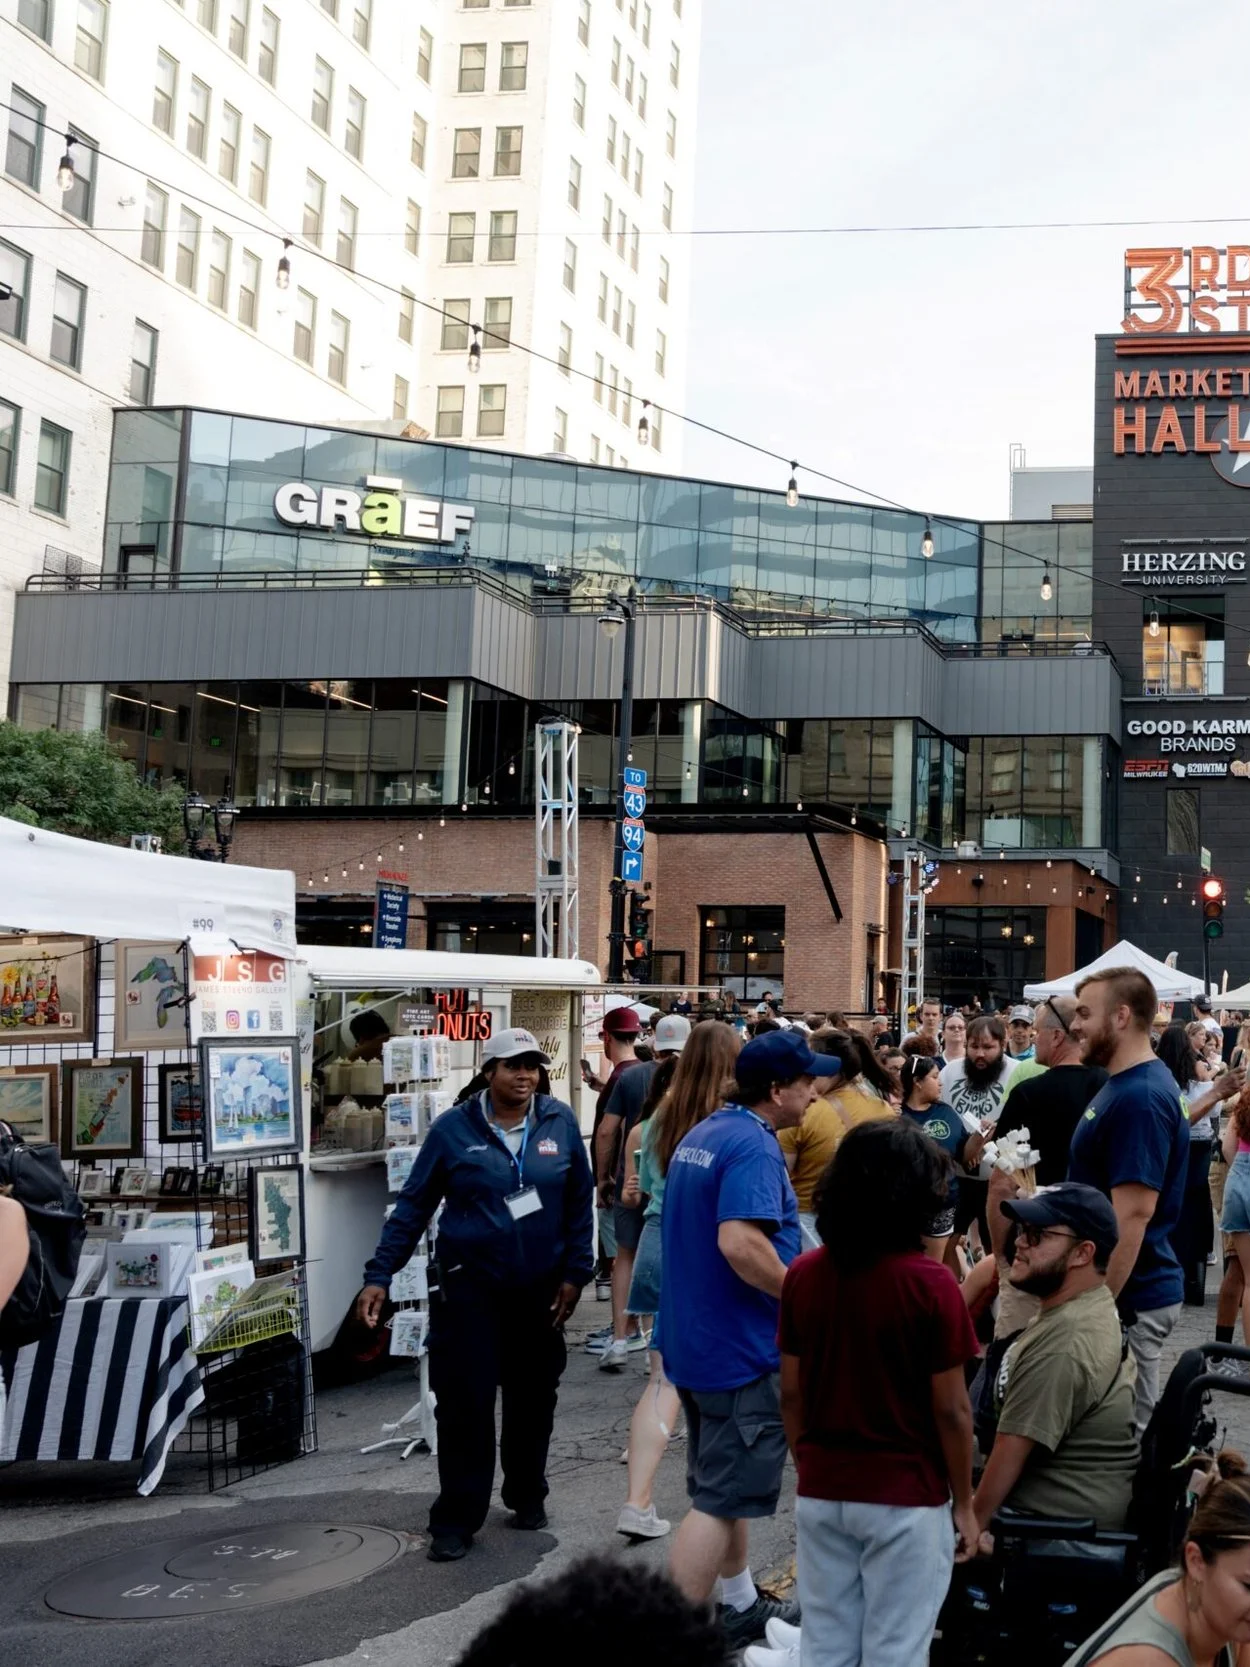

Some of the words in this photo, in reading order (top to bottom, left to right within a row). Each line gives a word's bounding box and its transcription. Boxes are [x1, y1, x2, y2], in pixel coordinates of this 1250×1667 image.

[1121, 551, 1247, 573] HERZING
[1142, 574, 1227, 586] UNIVERSITY
[1127, 719, 1187, 736] GOOD
[1160, 737, 1237, 753] BRANDS
[1123, 771, 1168, 779] MILWAUKEE
[1187, 762, 1228, 774] 620WTMJ
[630, 771, 642, 783] TO
[626, 795, 643, 813] 43
[624, 826, 641, 846] 94
[192, 918, 214, 932] #99
[207, 960, 222, 983] J
[237, 961, 253, 984] S
[268, 962, 285, 983] G
[195, 985, 219, 994] JAMES
[255, 985, 287, 994] GALLERY
[513, 995, 535, 1012] ICE
[540, 995, 568, 1012] COLD
[424, 1012, 490, 1040] ONUTS
[512, 1015, 568, 1031] LEMONADE
